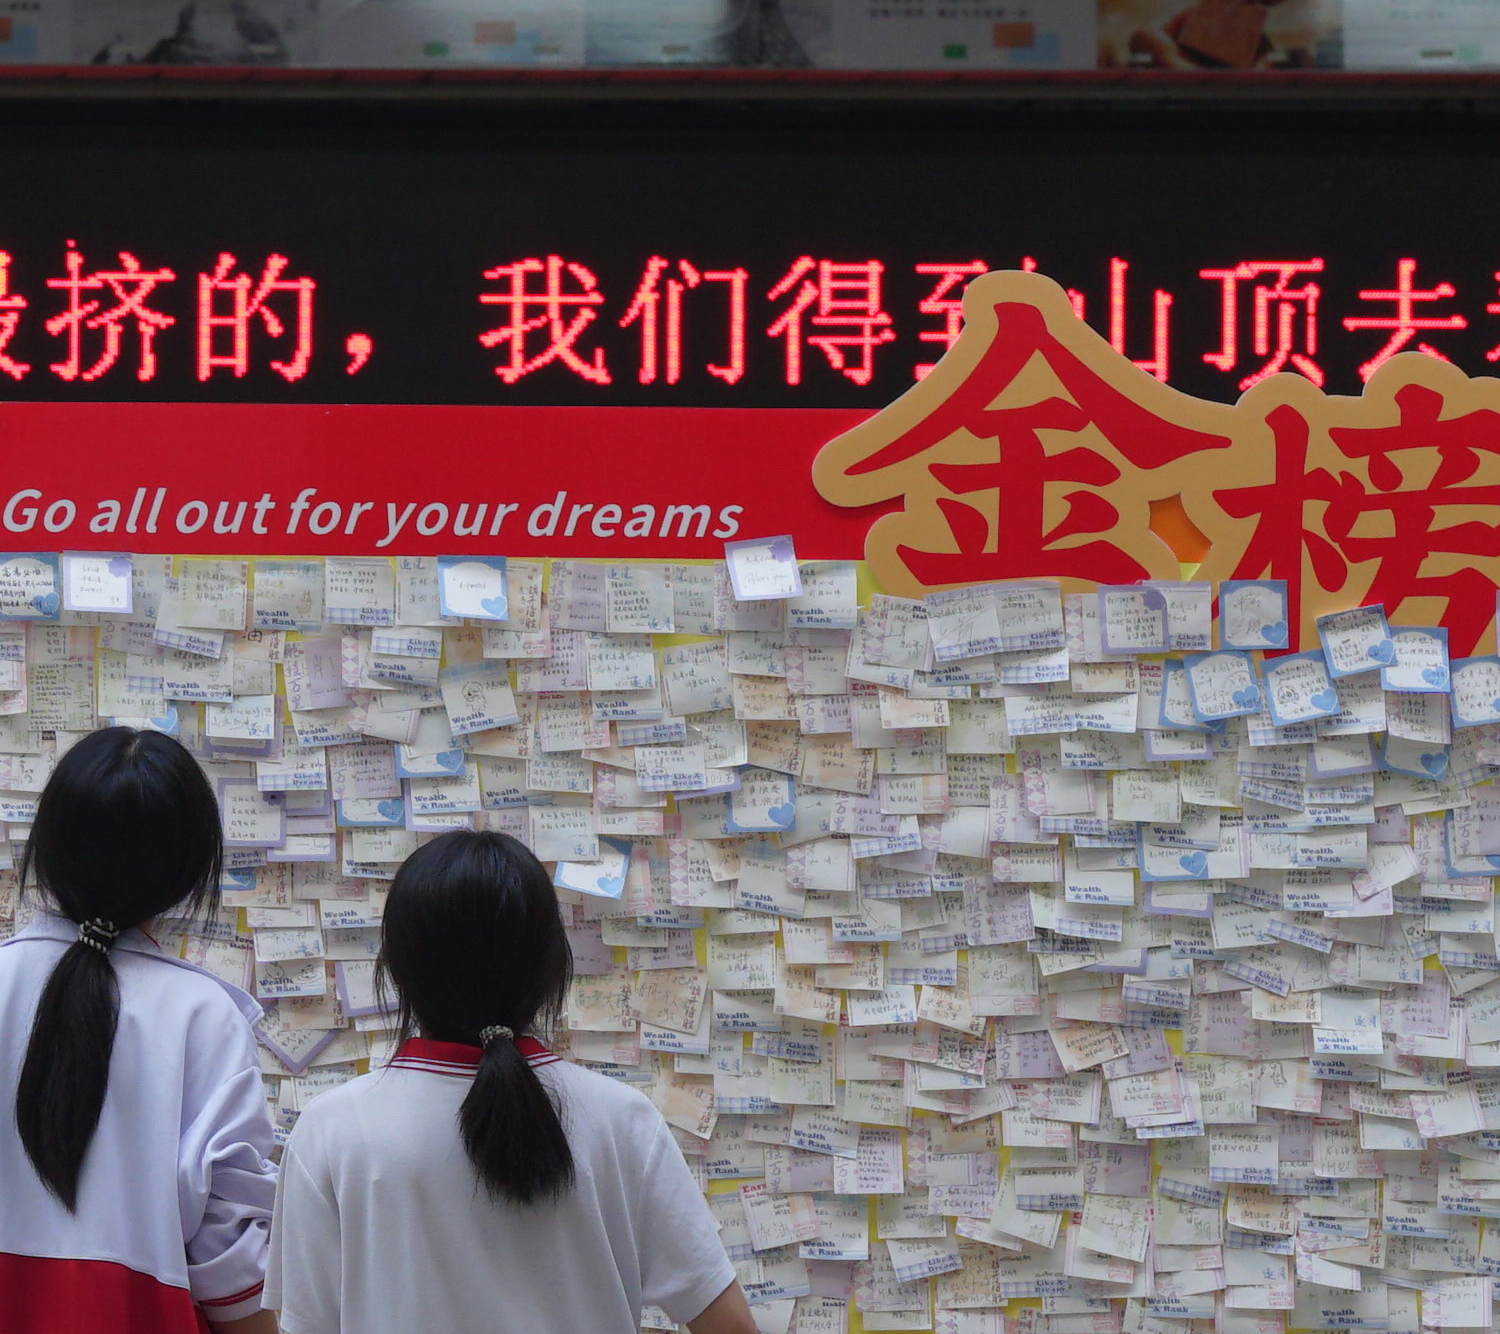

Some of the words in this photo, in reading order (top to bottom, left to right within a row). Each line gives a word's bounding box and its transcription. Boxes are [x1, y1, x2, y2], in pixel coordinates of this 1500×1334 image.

[1, 489, 77, 534] Go
[89, 488, 162, 534] all
[175, 491, 276, 535] out
[289, 488, 375, 536] for
[376, 498, 519, 548] your
[526, 491, 745, 539] dreams
